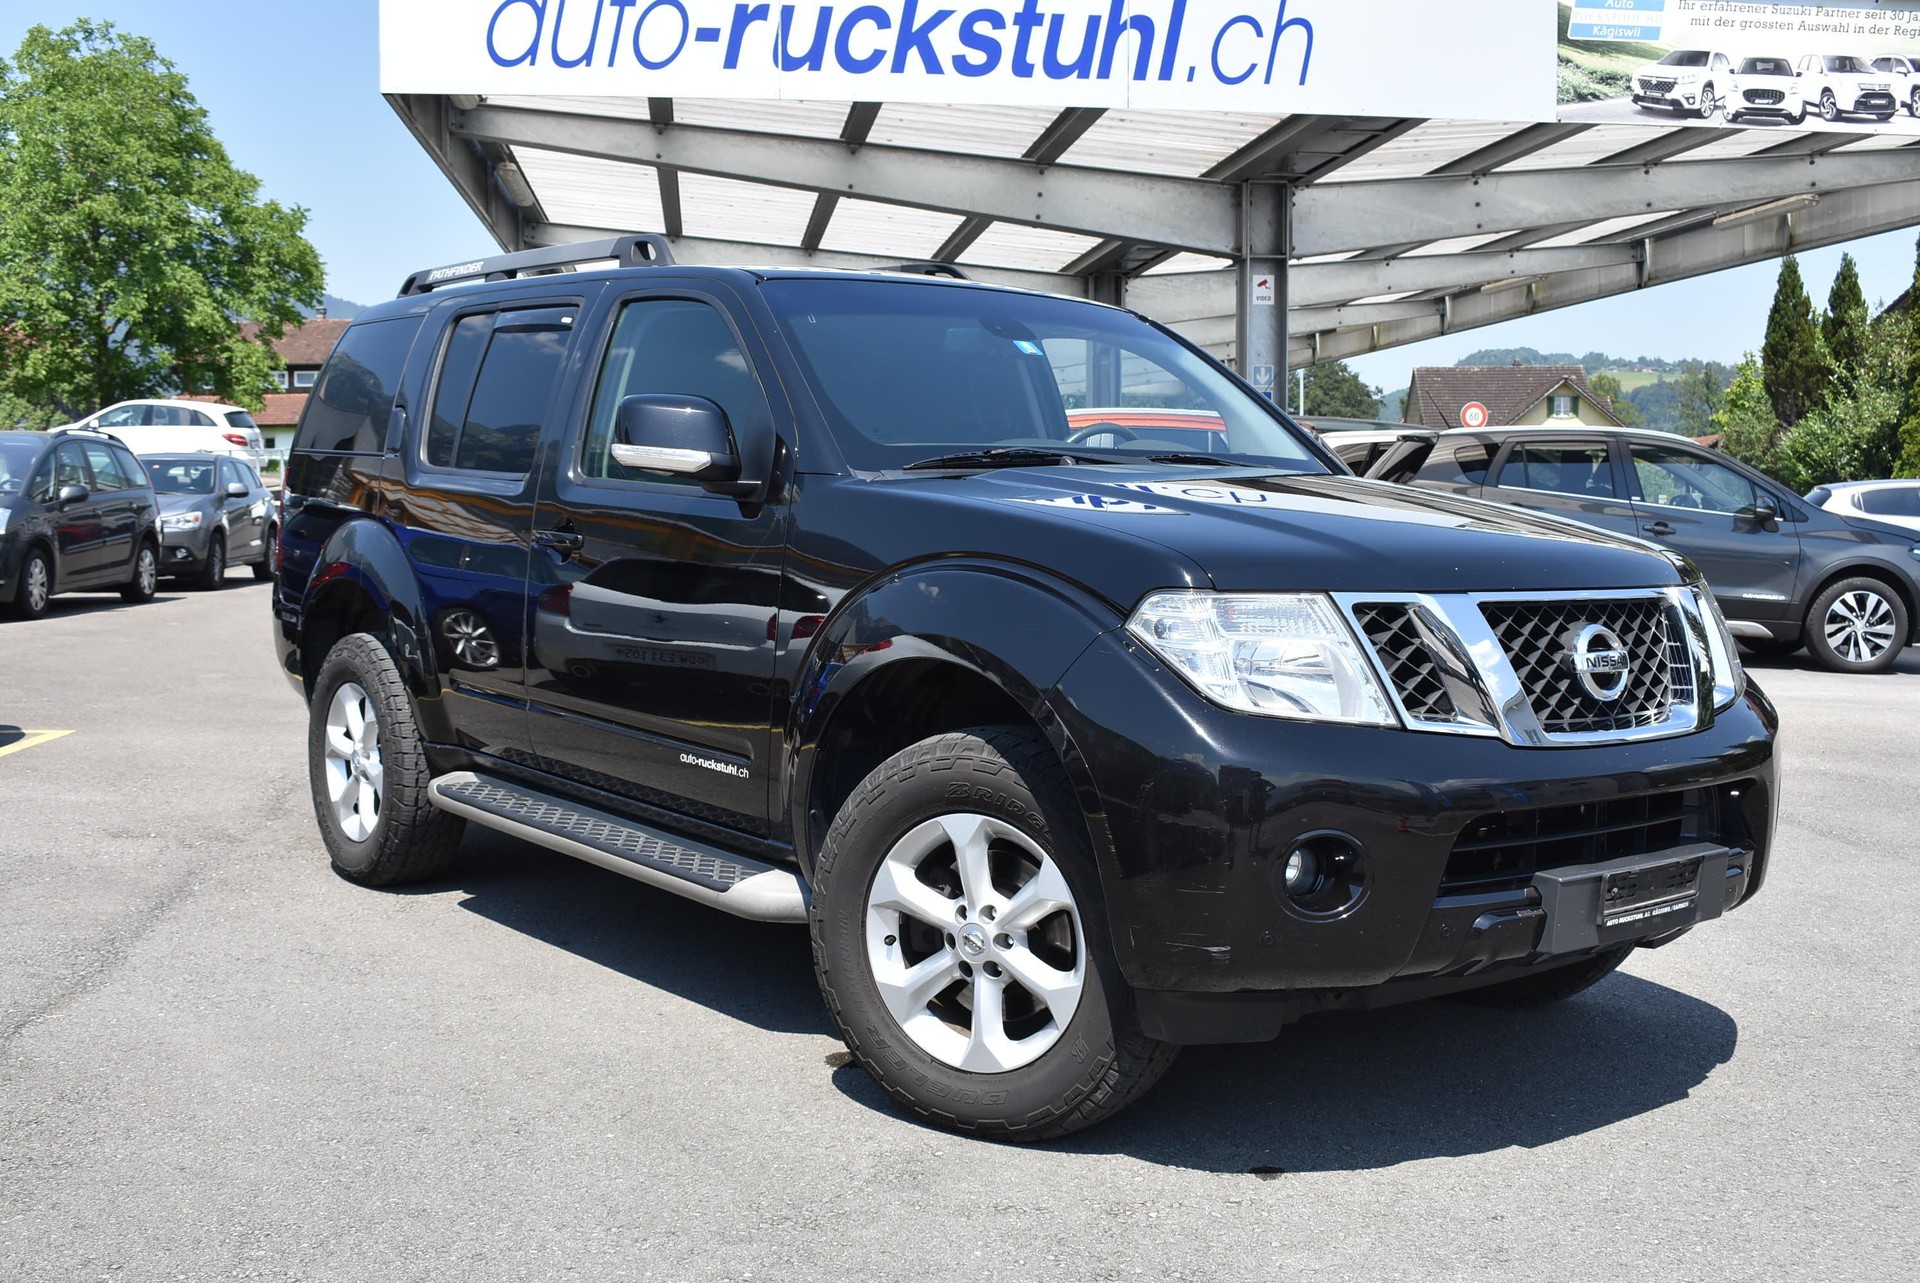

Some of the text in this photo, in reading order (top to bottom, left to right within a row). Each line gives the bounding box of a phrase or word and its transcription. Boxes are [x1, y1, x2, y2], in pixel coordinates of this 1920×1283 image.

[1605, 0, 1634, 9] Auto
[1678, 0, 1920, 24] Ihr erfahrener Suzuki Partner seit 30 Ja
[1592, 25, 1641, 39] Kägiswil
[1690, 16, 1710, 26] mit
[1714, 17, 1736, 28] der
[1740, 18, 1794, 31] grössten
[1797, 21, 1850, 34] Auswahl
[1853, 23, 1865, 34] in
[1868, 24, 1890, 35] der
[487, 0, 1313, 86] auto-ruckstuhl.ch
[429, 261, 484, 280] PATHFINDER
[1469, 412, 1480, 421] 60
[680, 753, 749, 779] auto-ruckstuhl.ch
[1606, 918, 1619, 927] AUTO
